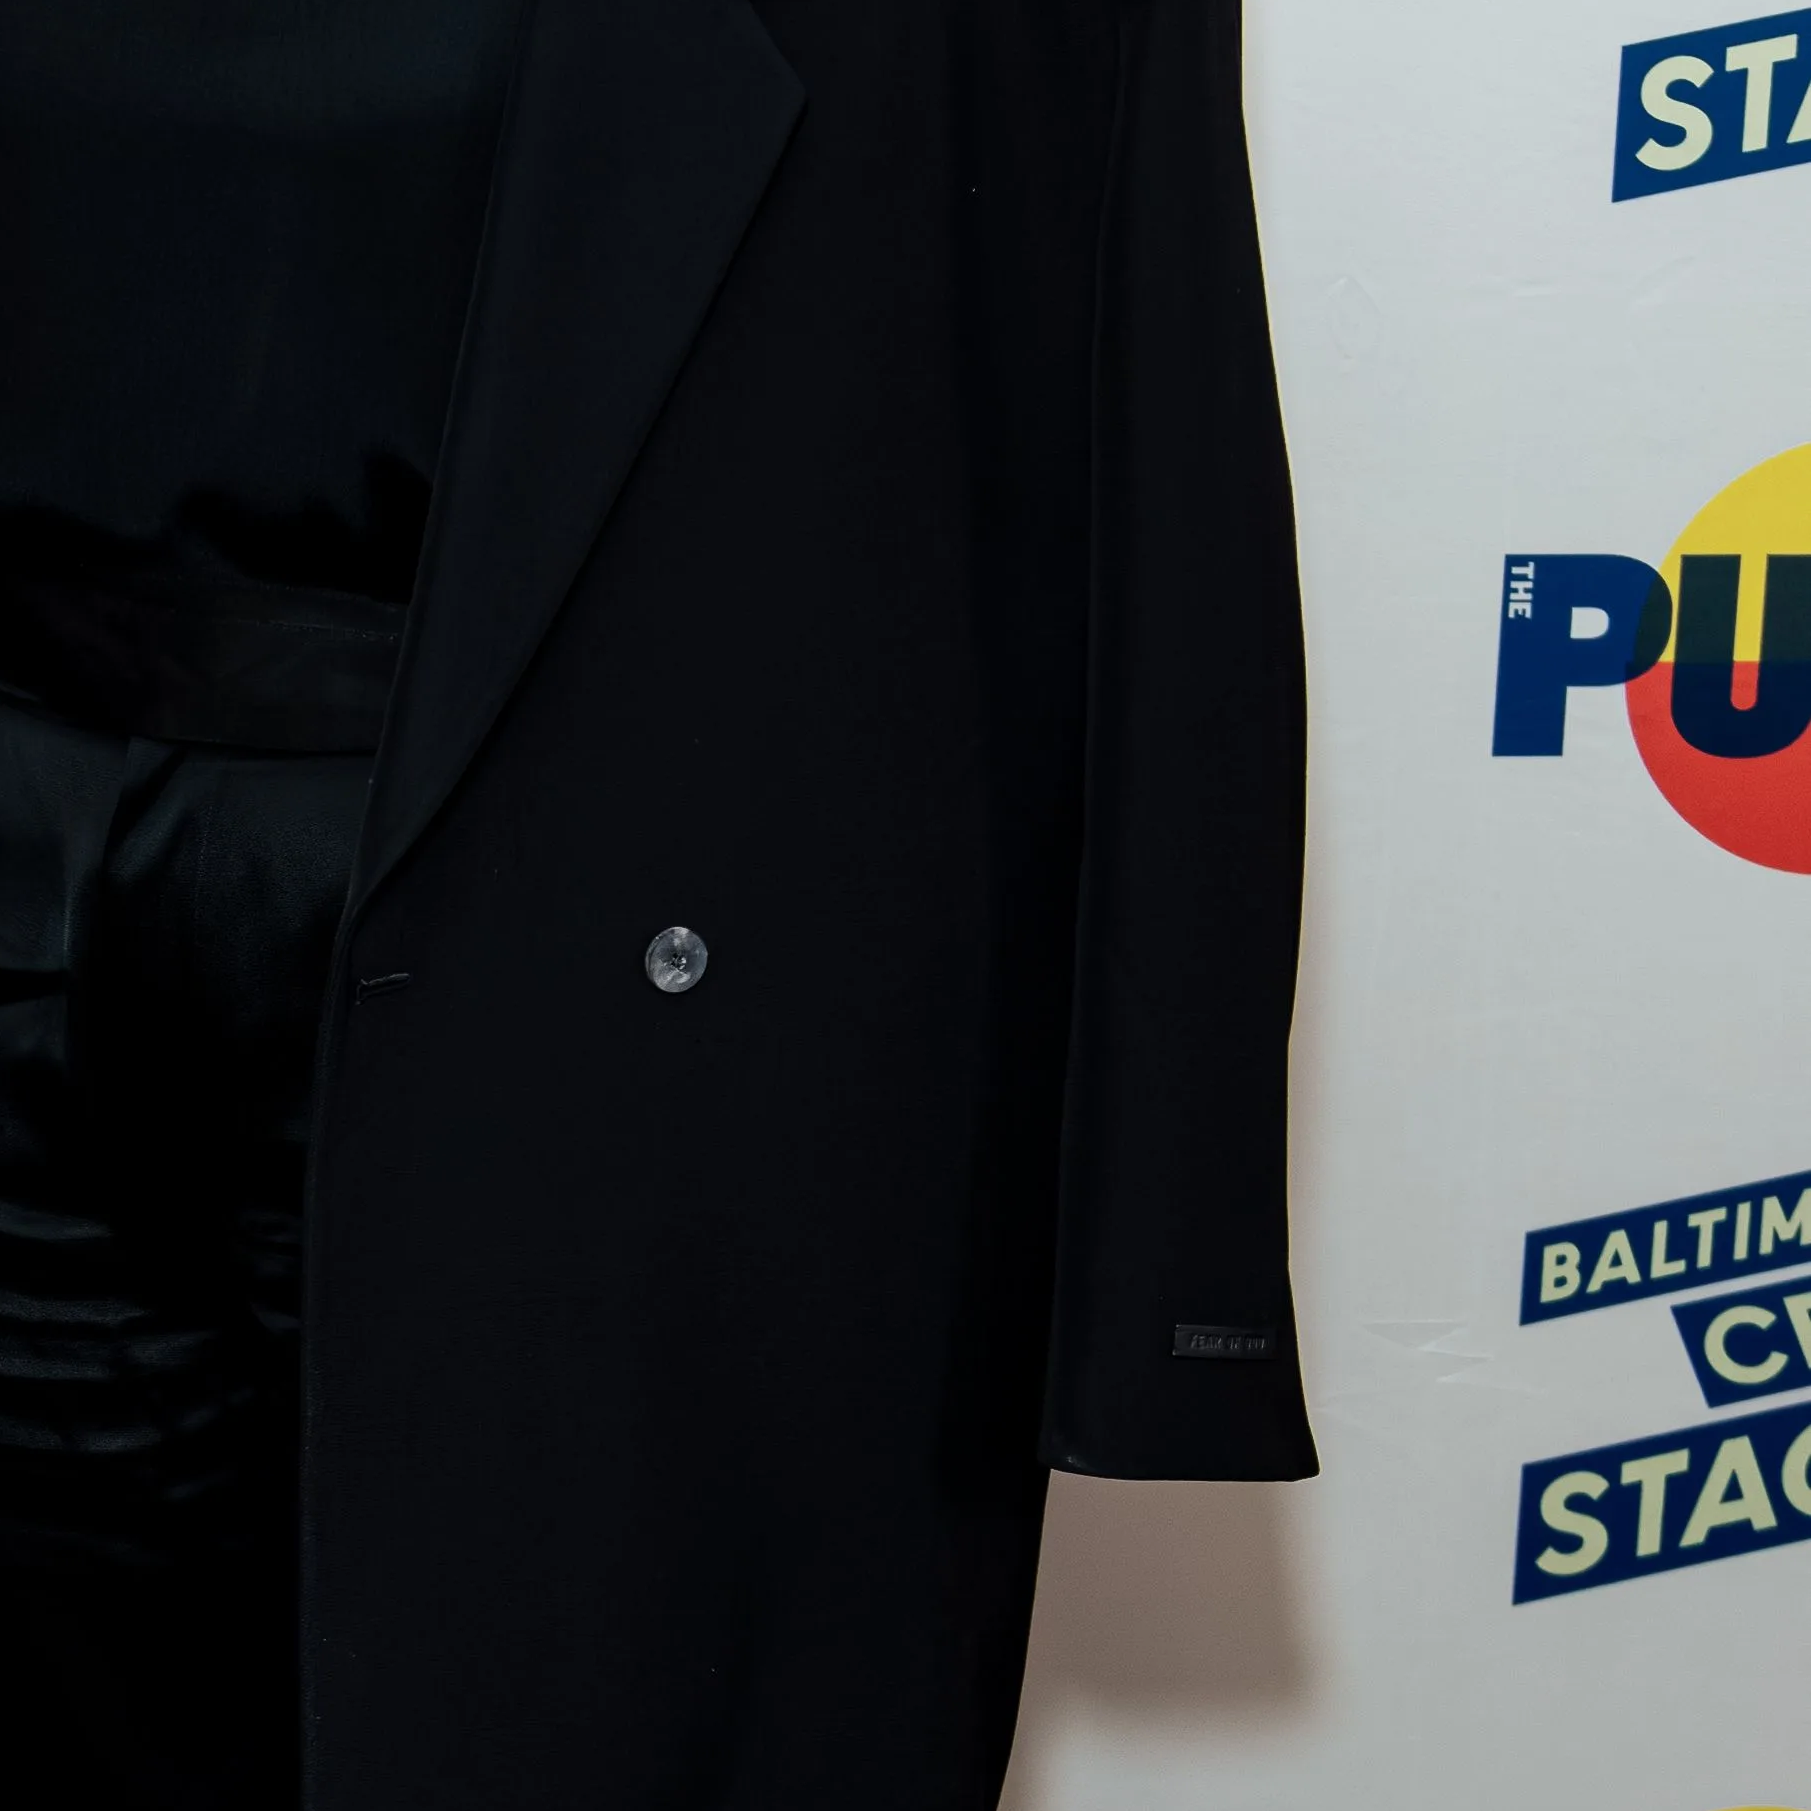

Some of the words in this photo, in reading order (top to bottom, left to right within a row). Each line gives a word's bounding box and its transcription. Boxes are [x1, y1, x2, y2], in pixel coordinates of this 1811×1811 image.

[1635, 33, 1811, 171] ST
[1508, 561, 1535, 619] THE
[1540, 1187, 1811, 1303] BALTIM
